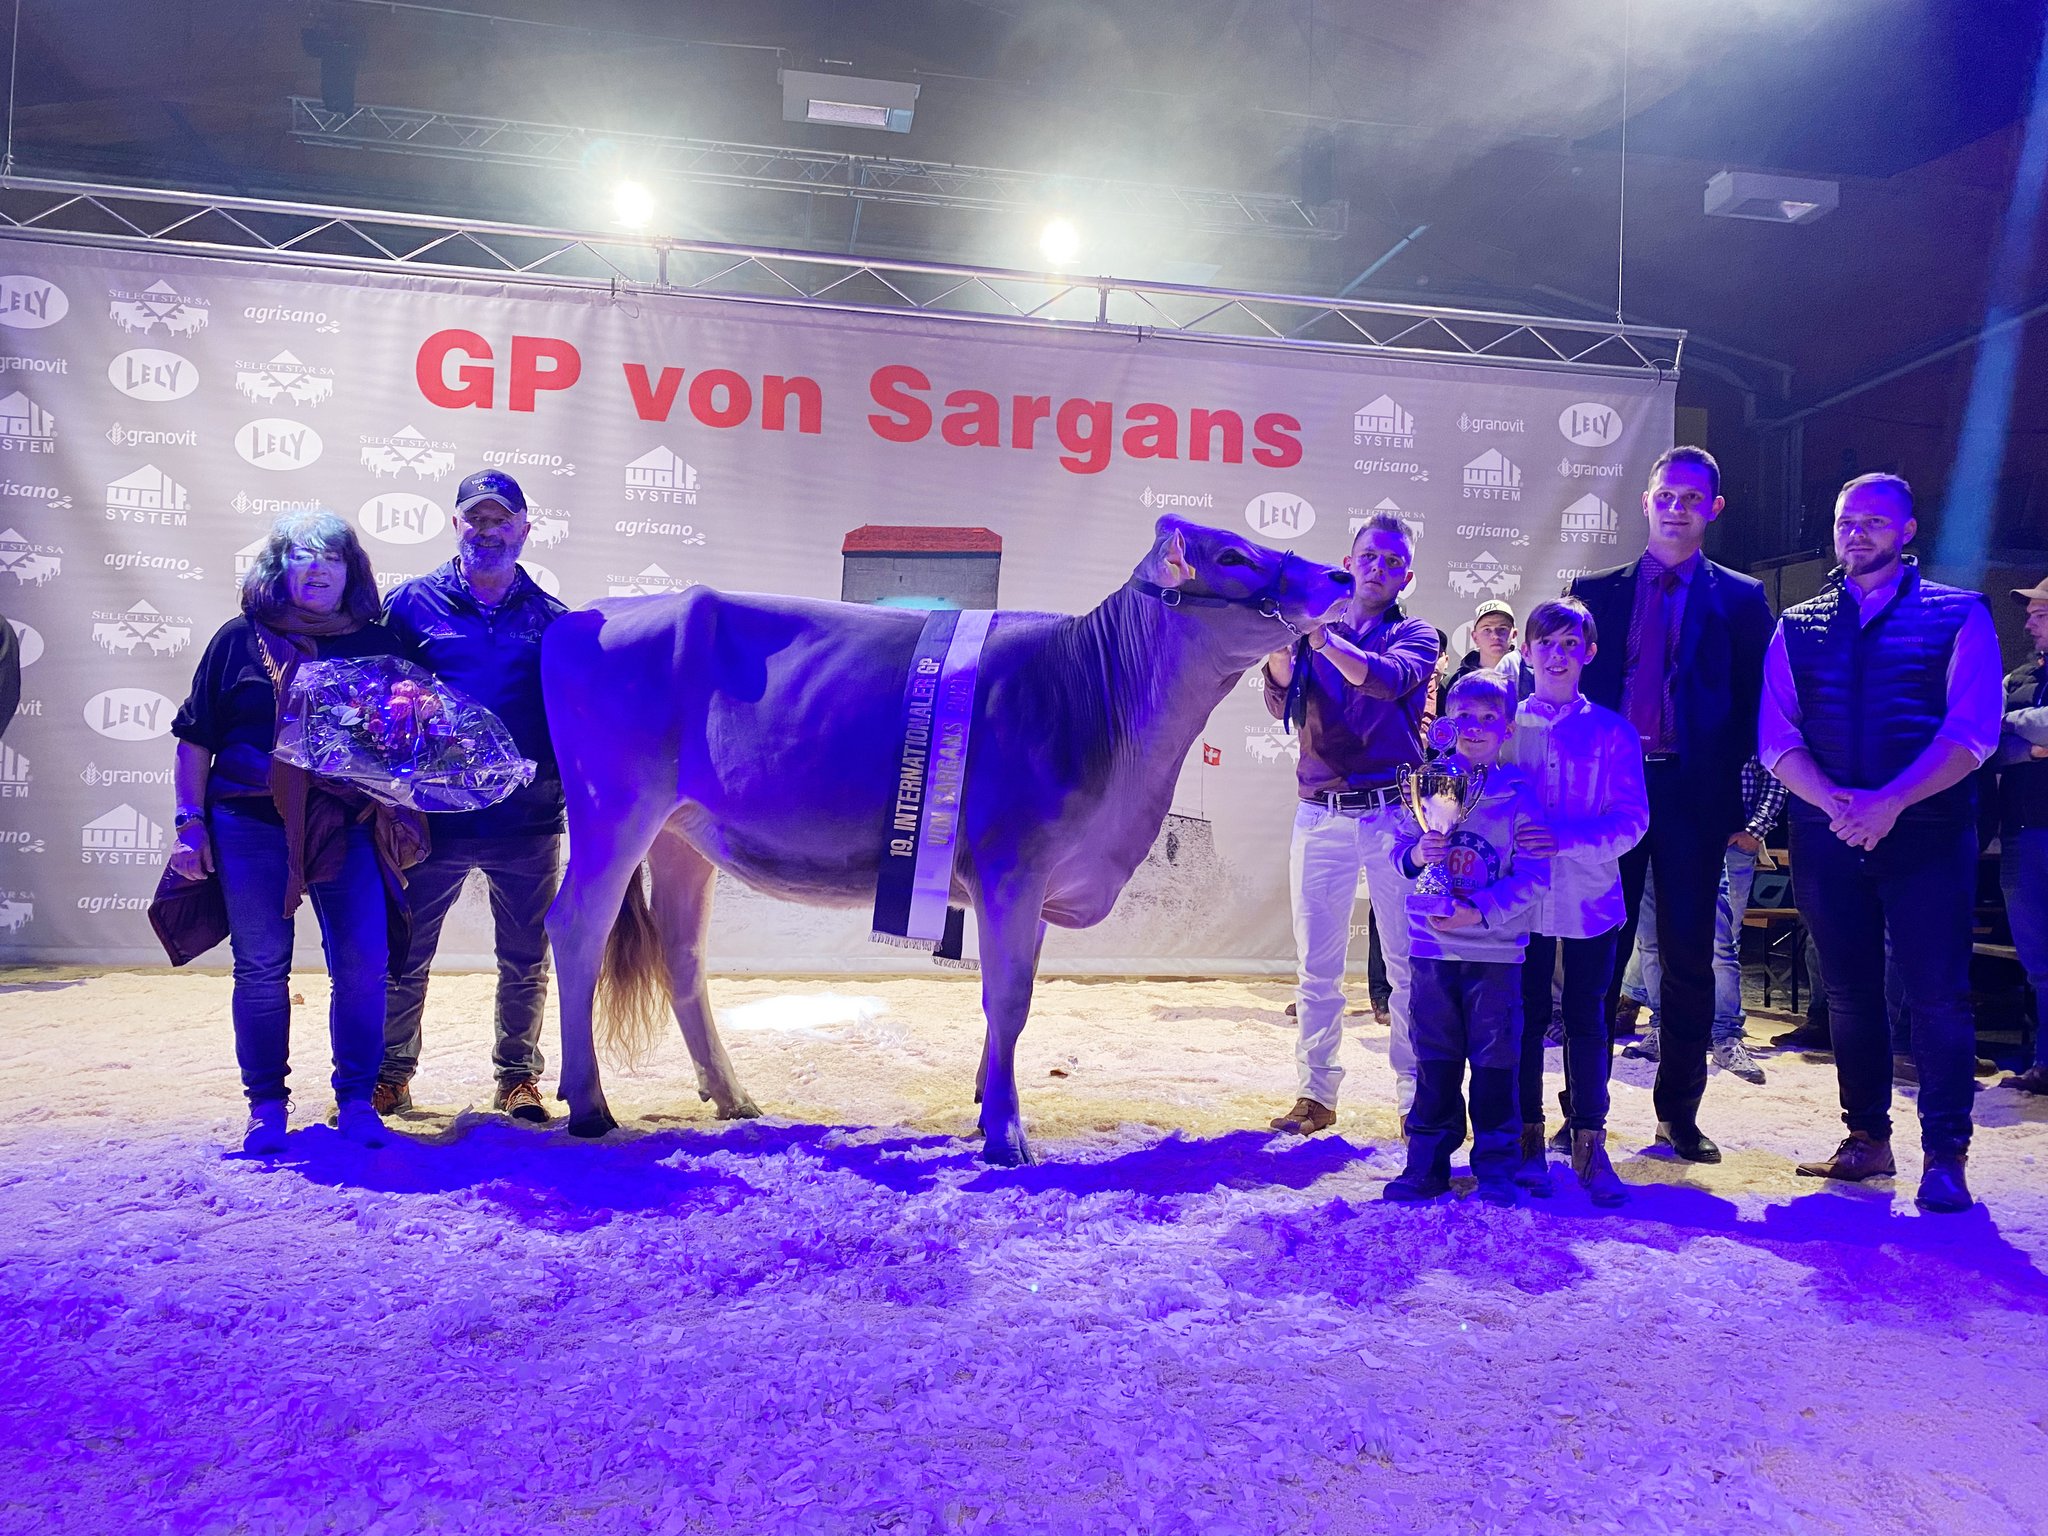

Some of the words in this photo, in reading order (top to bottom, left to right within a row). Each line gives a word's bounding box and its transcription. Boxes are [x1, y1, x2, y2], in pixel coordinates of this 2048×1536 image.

[159, 294, 191, 305] STAR
[194, 297, 211, 307] SA
[244, 304, 327, 324] agrisano
[126, 356, 182, 393] LELY
[286, 363, 317, 375] STAR
[320, 366, 335, 377] SA
[416, 328, 582, 413] GP
[622, 362, 823, 435] von
[867, 364, 1304, 475] Sargans
[1471, 418, 1525, 433] granovit
[1571, 409, 1612, 439] LELY
[127, 428, 198, 447] granovit
[252, 426, 306, 460] LELY
[409, 438, 440, 448] STAR
[443, 441, 457, 450] SA
[1354, 434, 1414, 449] SYSTEM
[2, 440, 54, 454] STEM
[482, 448, 563, 467] agrisano
[1354, 457, 1419, 475] agrisano
[1573, 464, 1624, 479] granovit
[624, 489, 697, 506] SYSTEM
[1156, 492, 1214, 509] granovit
[1462, 488, 1521, 502] SYSTEM
[252, 498, 321, 515] granovit
[527, 507, 552, 516] TAR
[555, 508, 571, 517] SA
[1259, 499, 1304, 531] LELY
[106, 508, 187, 526] SYSTEM
[375, 501, 429, 535] LELY
[615, 518, 693, 538] agrisano
[1456, 522, 1520, 540] agrisano
[1560, 532, 1618, 545] SYSTEM
[8, 543, 42, 554] STAR
[46, 545, 64, 555] SA
[104, 551, 190, 571] agrisano
[1486, 562, 1511, 571] STAR
[1512, 563, 1524, 572] SA
[654, 578, 682, 586] STAR
[685, 579, 700, 587] SA
[143, 614, 173, 624] STAR
[176, 616, 193, 625] SA
[916, 657, 940, 675] GP
[102, 696, 162, 731] LELY
[893, 679, 937, 832] INTERNATIONALER
[934, 722, 965, 806] SARGANS
[101, 768, 175, 787] granovit
[890, 835, 915, 857] 19.
[81, 852, 162, 865] SYSTEM
[1449, 849, 1476, 876] 68
[77, 893, 152, 914] agrisan
